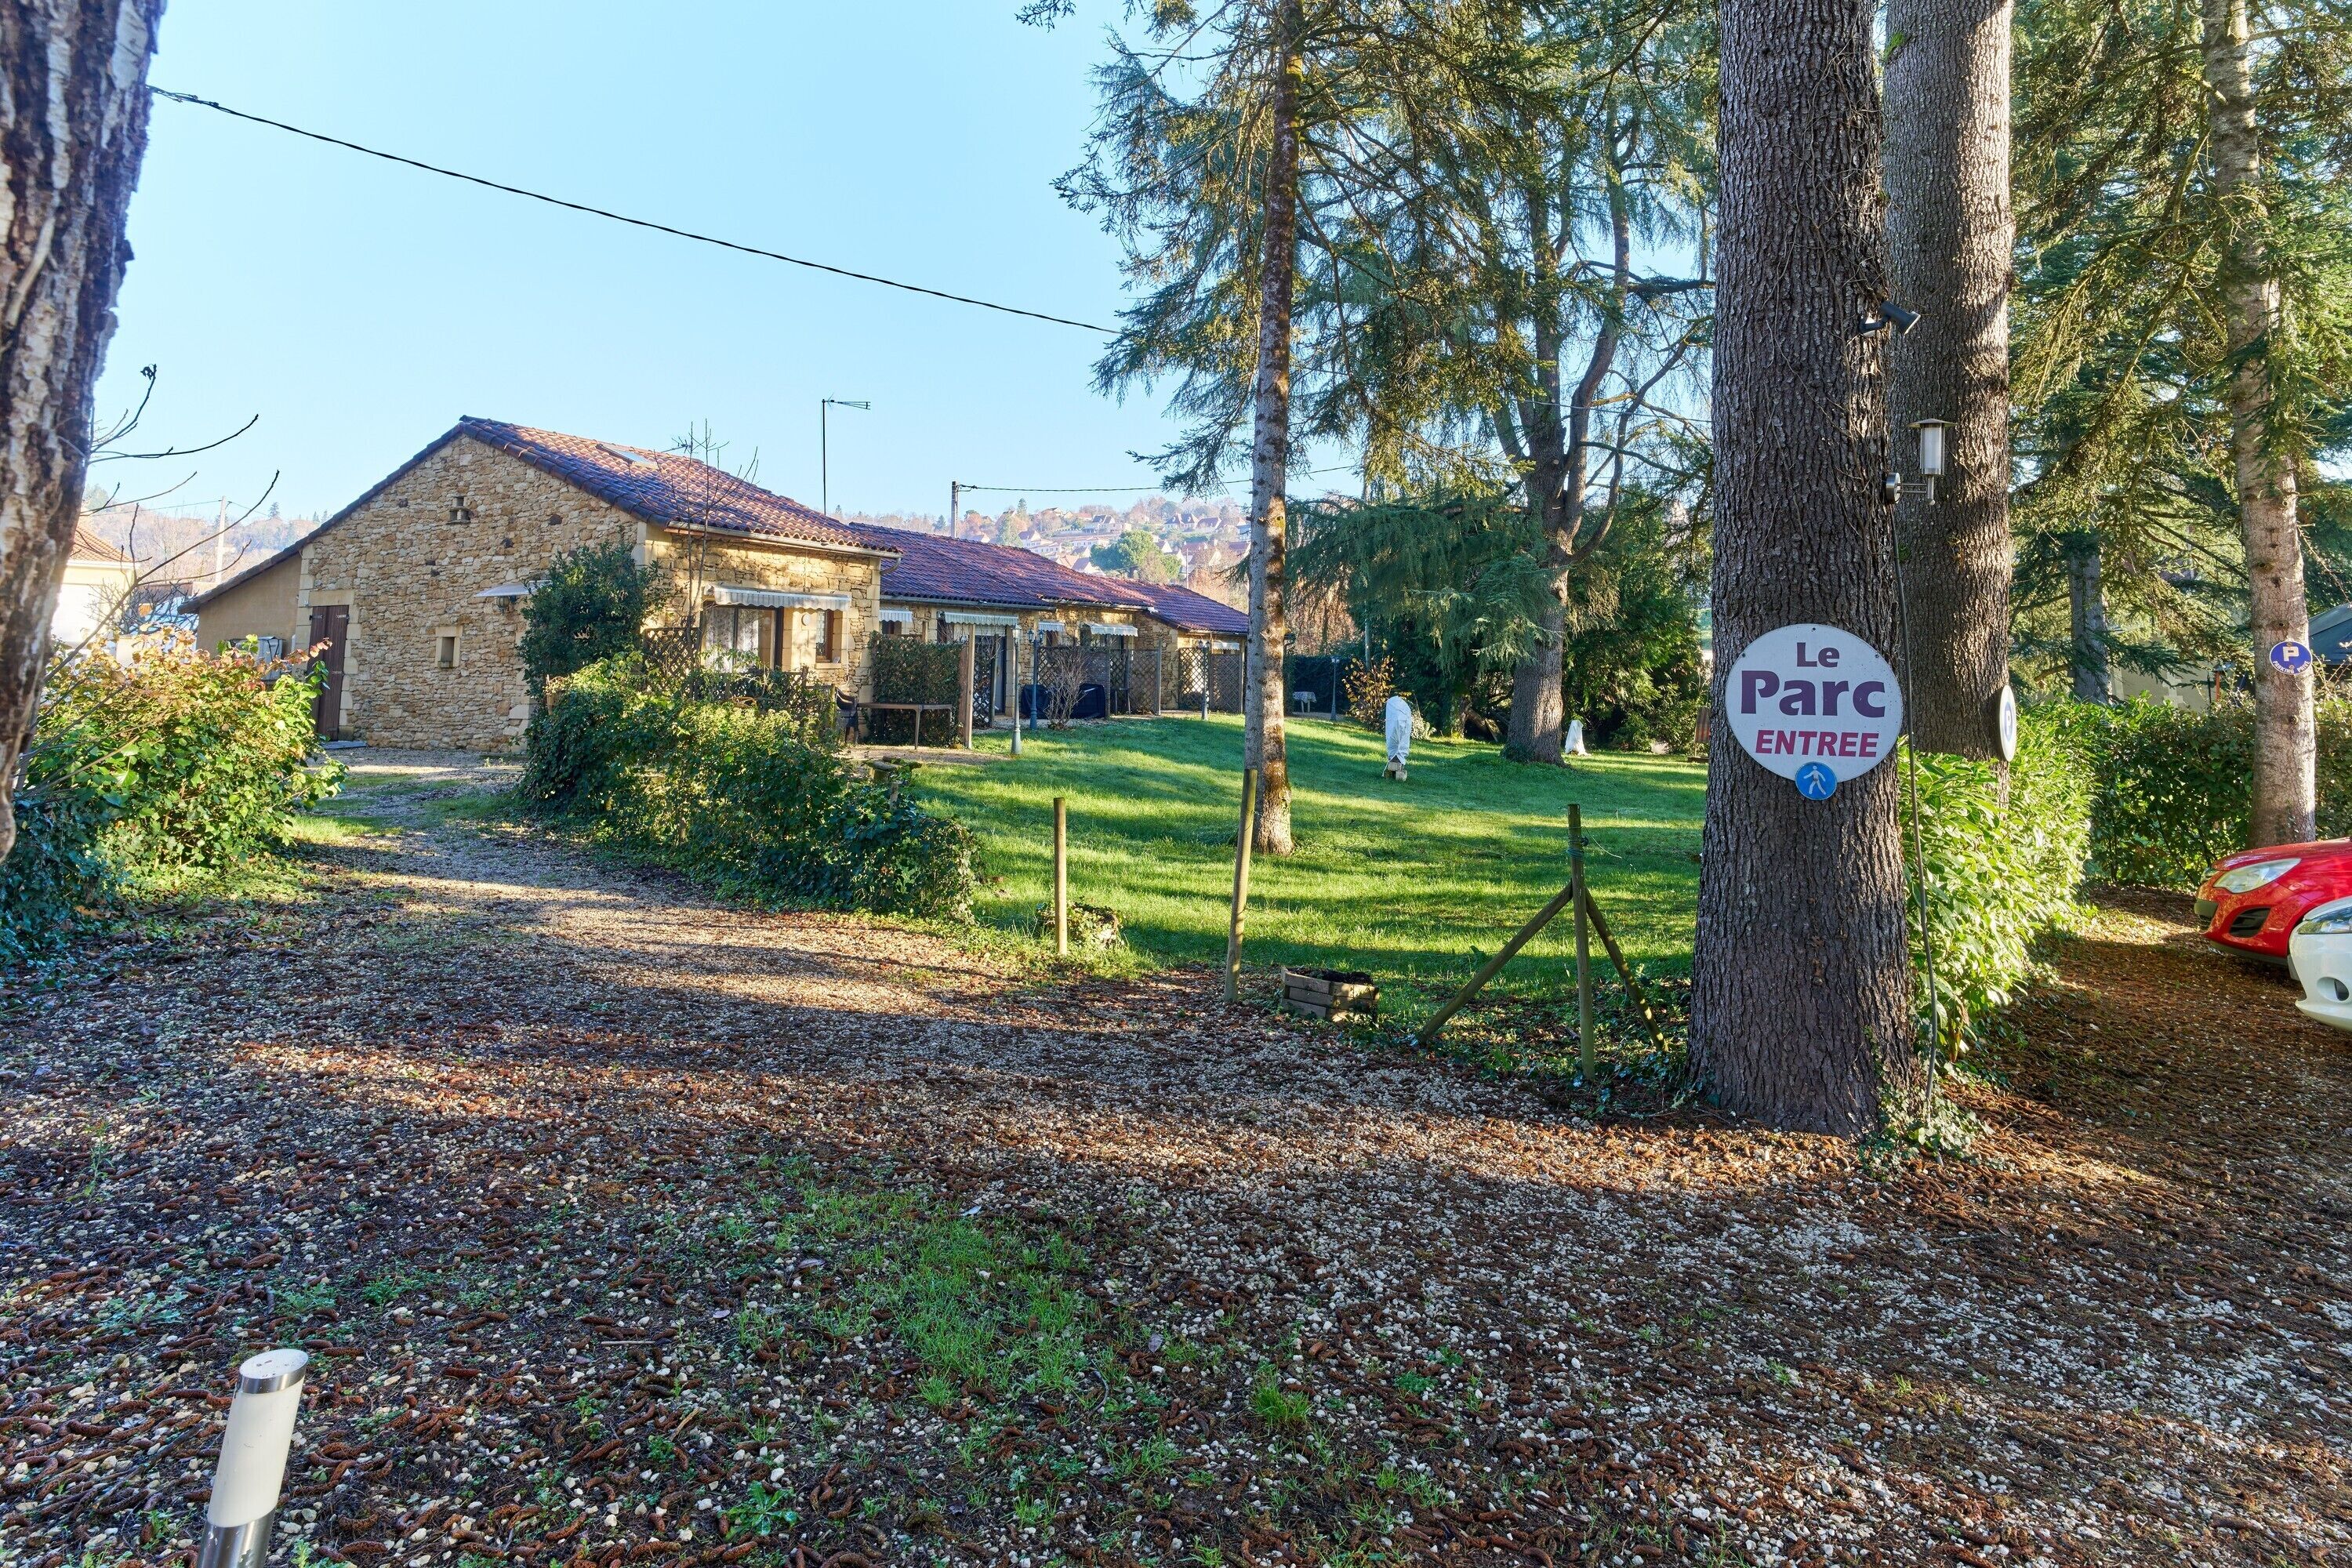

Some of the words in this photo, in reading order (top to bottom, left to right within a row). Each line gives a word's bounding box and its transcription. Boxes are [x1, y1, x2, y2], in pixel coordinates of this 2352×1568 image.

[1797, 642, 1840, 667] Le
[2272, 660, 2295, 673] PARKING
[2282, 646, 2299, 662] P
[1740, 670, 1886, 718] Parc
[1755, 729, 1879, 757] ENTREE
